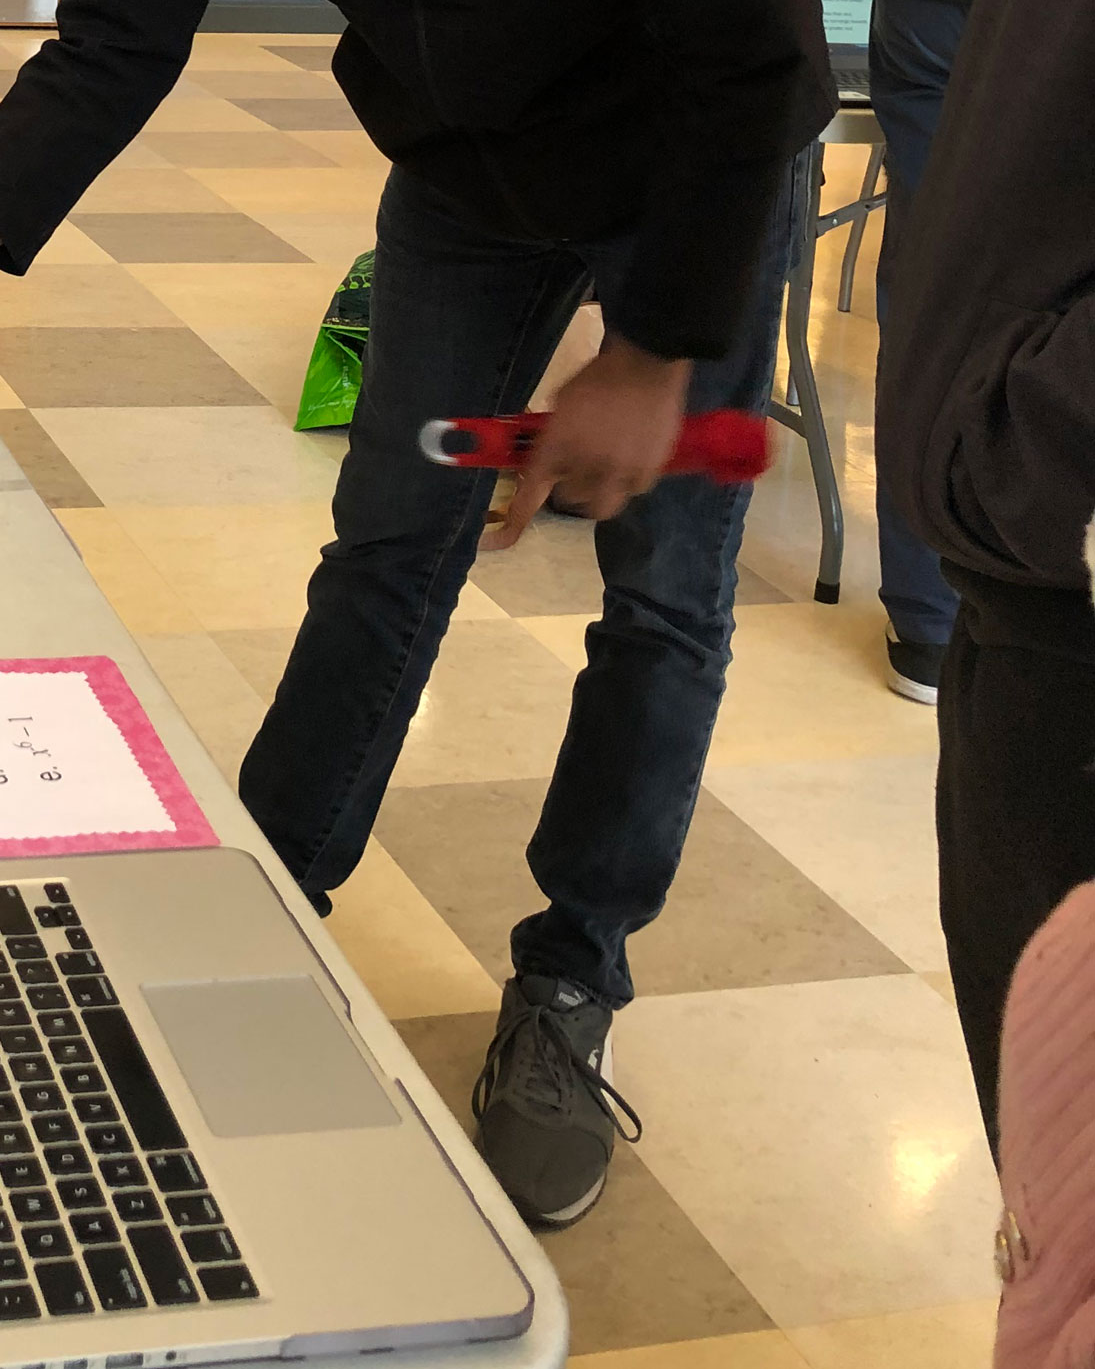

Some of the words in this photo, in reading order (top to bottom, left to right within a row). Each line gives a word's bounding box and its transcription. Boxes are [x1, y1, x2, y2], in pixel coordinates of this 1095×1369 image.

[40, 766, 62, 781] e.
[3, 1008, 15, 1016] K
[25, 1063, 37, 1071] H
[77, 1074, 89, 1082] B
[36, 1091, 49, 1100] G
[89, 1103, 102, 1112] V
[4, 1133, 16, 1142] R
[103, 1133, 115, 1142] C
[61, 1154, 74, 1164] D
[15, 1166, 29, 1175] E
[116, 1165, 130, 1176] X
[74, 1187, 87, 1198] S
[130, 1199, 144, 1209] Z
